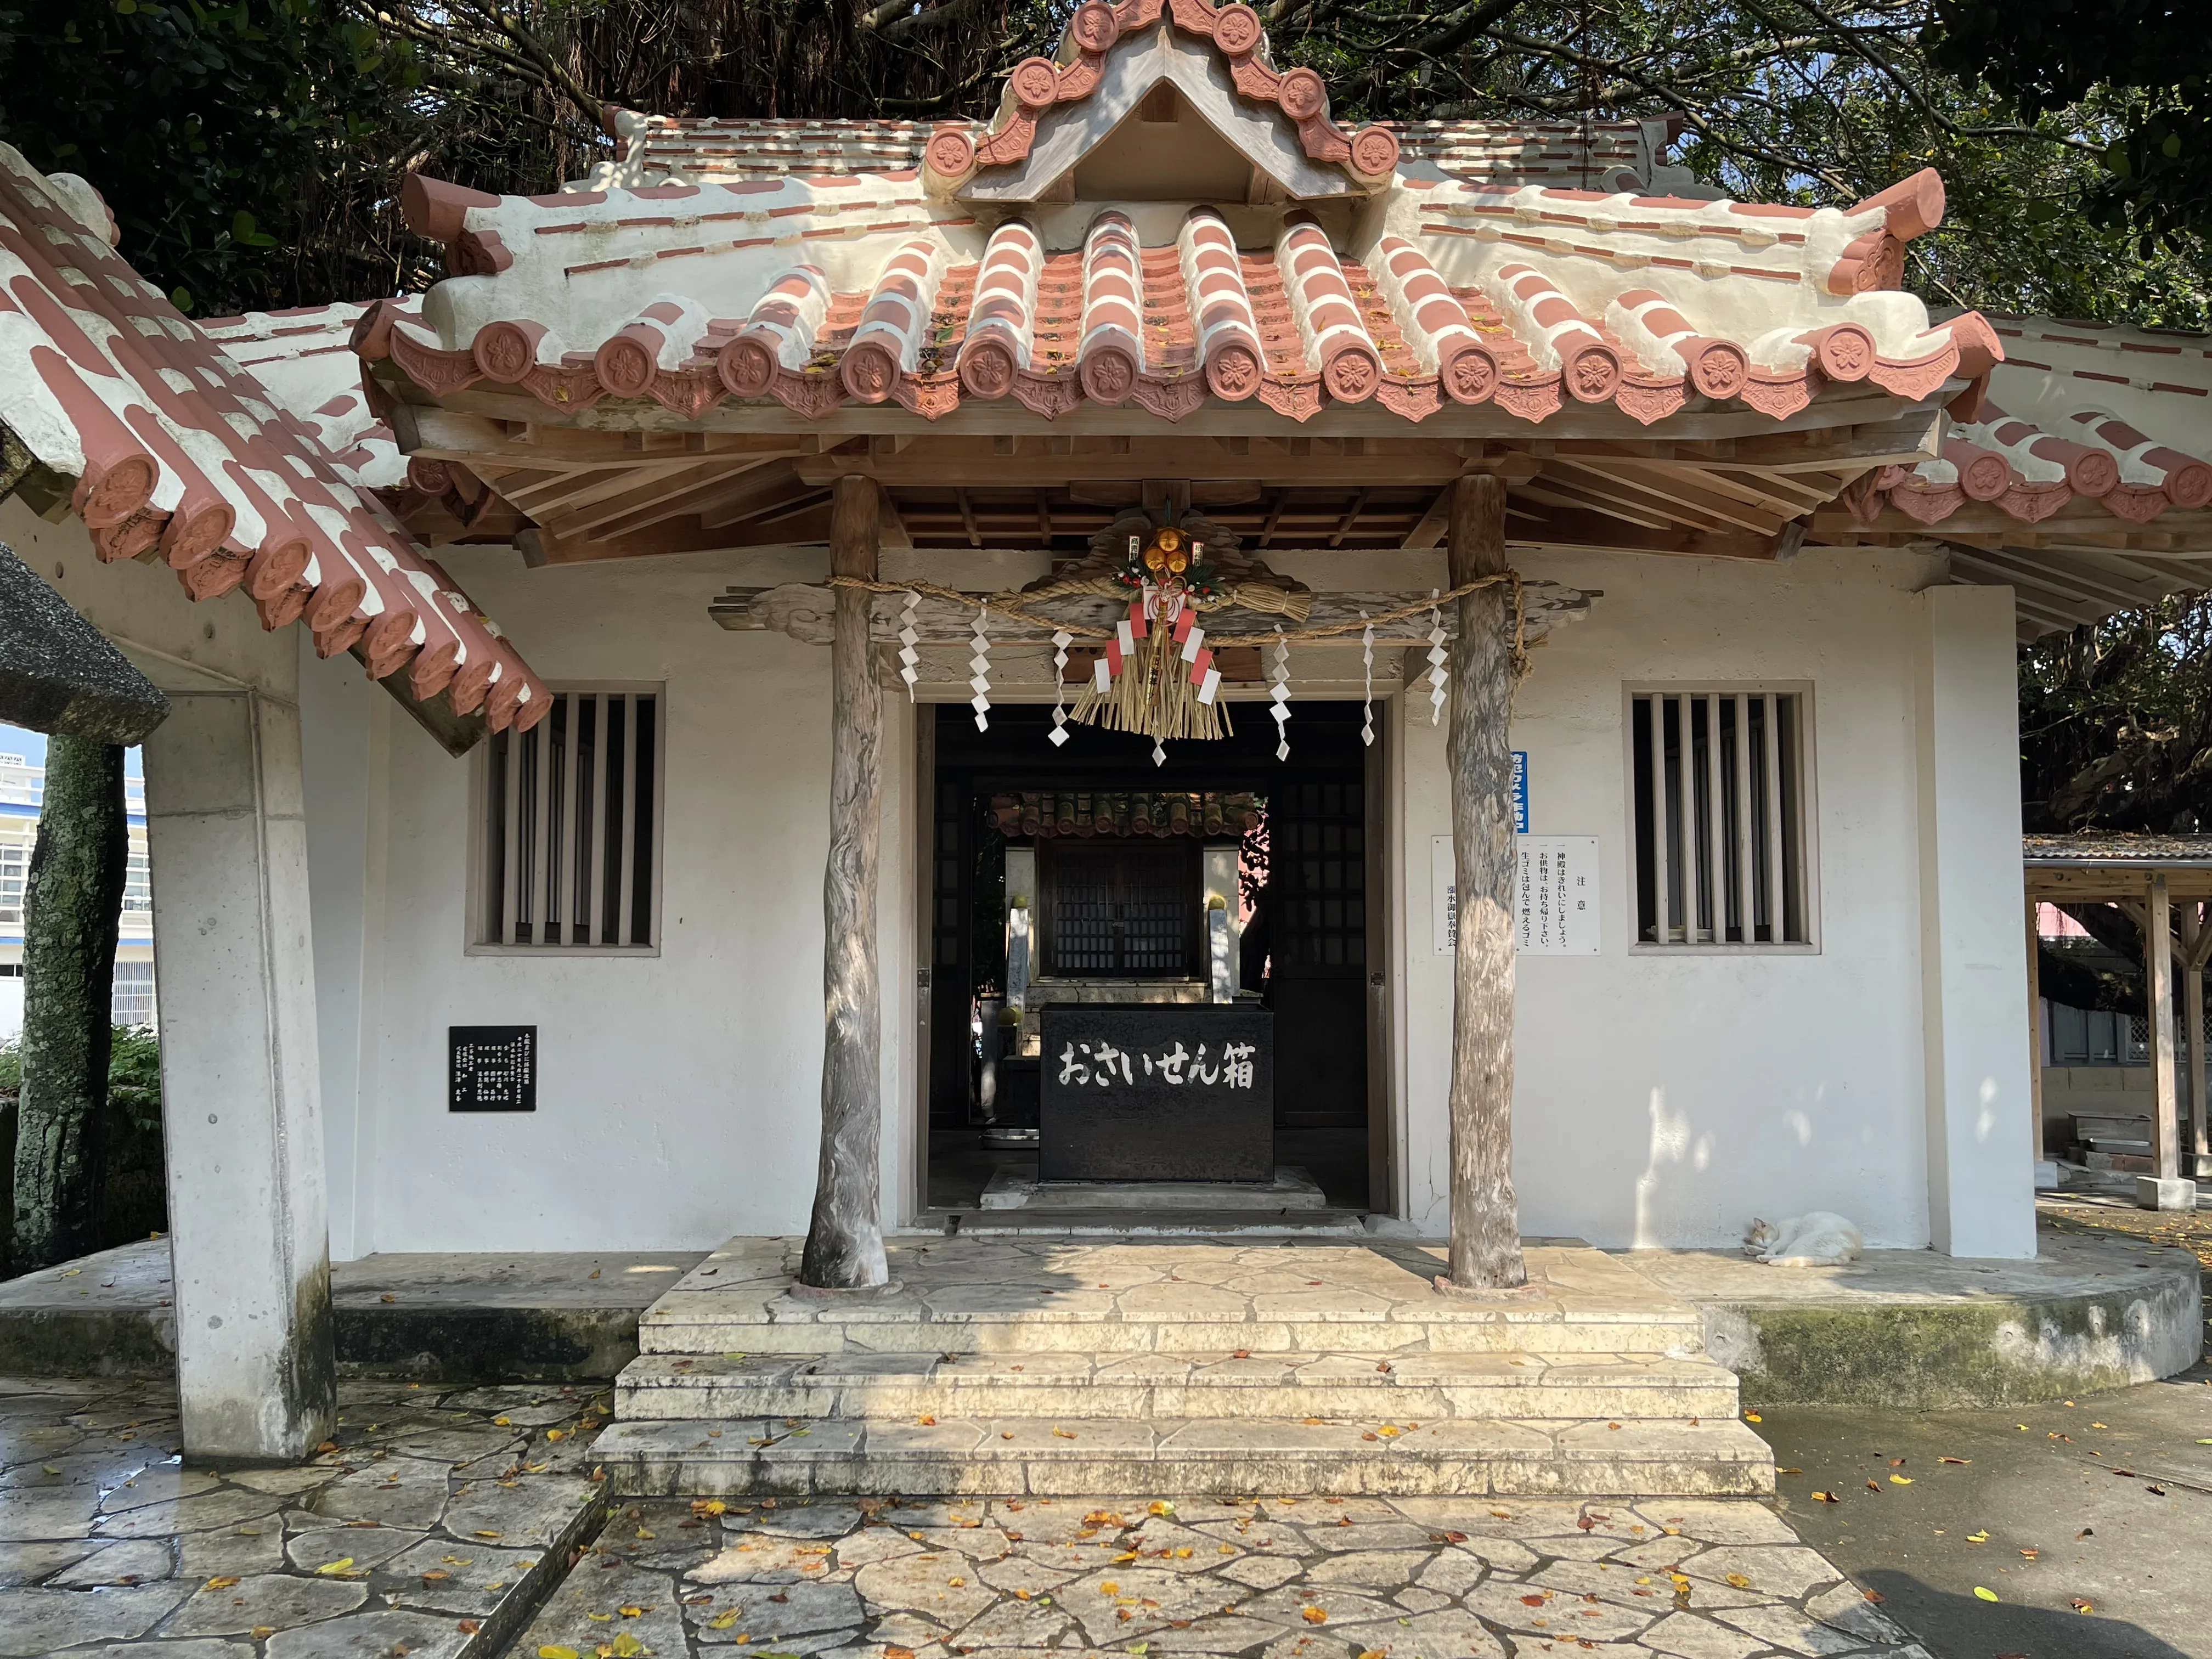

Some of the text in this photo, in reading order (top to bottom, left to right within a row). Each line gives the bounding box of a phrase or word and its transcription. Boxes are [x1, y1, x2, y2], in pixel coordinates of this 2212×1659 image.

[1058, 1041, 1256, 1090] おさいせん箱
